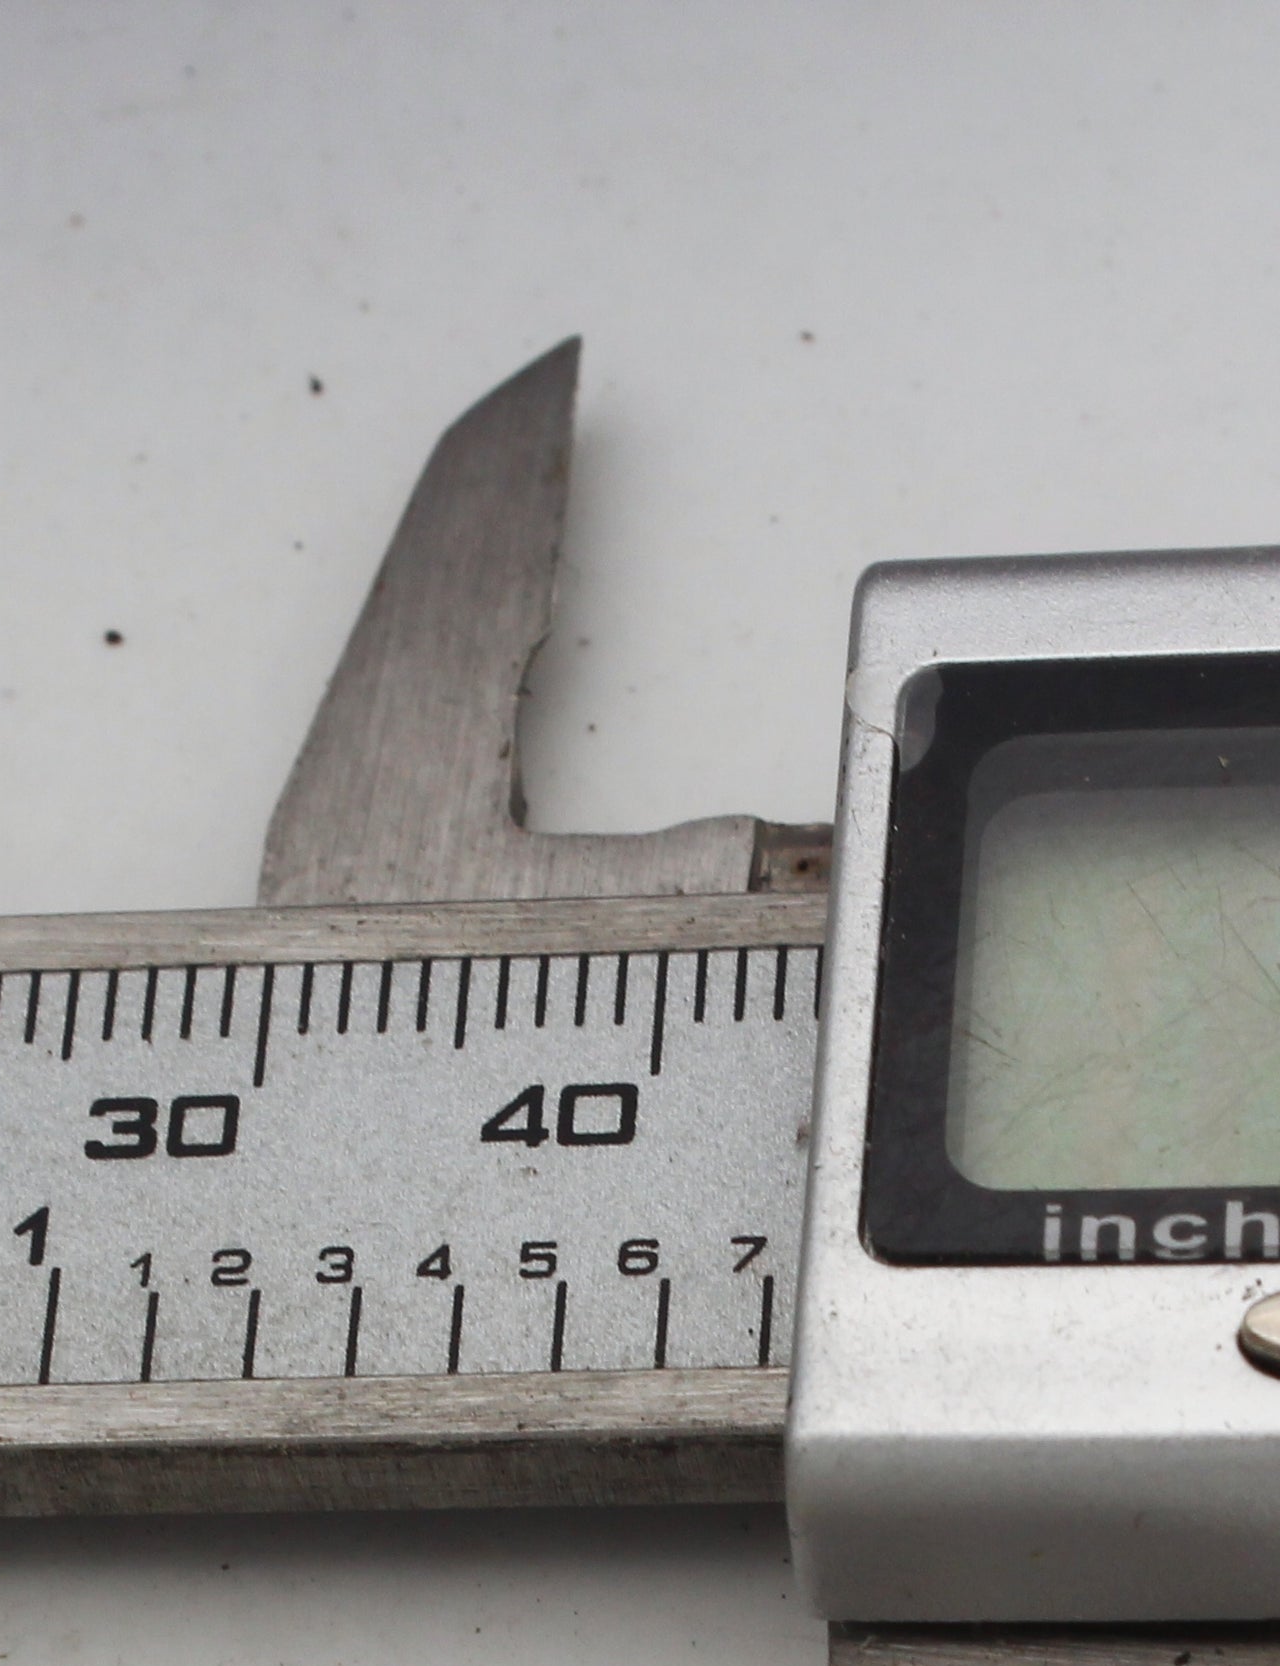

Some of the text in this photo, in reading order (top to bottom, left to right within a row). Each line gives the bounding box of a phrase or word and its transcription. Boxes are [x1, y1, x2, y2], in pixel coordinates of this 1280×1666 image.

[83, 1094, 241, 1161] 30
[480, 1083, 639, 1147] 40
[13, 1207, 51, 1267] 1
[129, 1252, 153, 1288] 1
[210, 1248, 253, 1287] 2
[314, 1246, 356, 1284] 3
[415, 1243, 453, 1281] 4
[519, 1241, 558, 1279] 5
[617, 1238, 659, 1276] 6
[730, 1236, 768, 1273] 7
